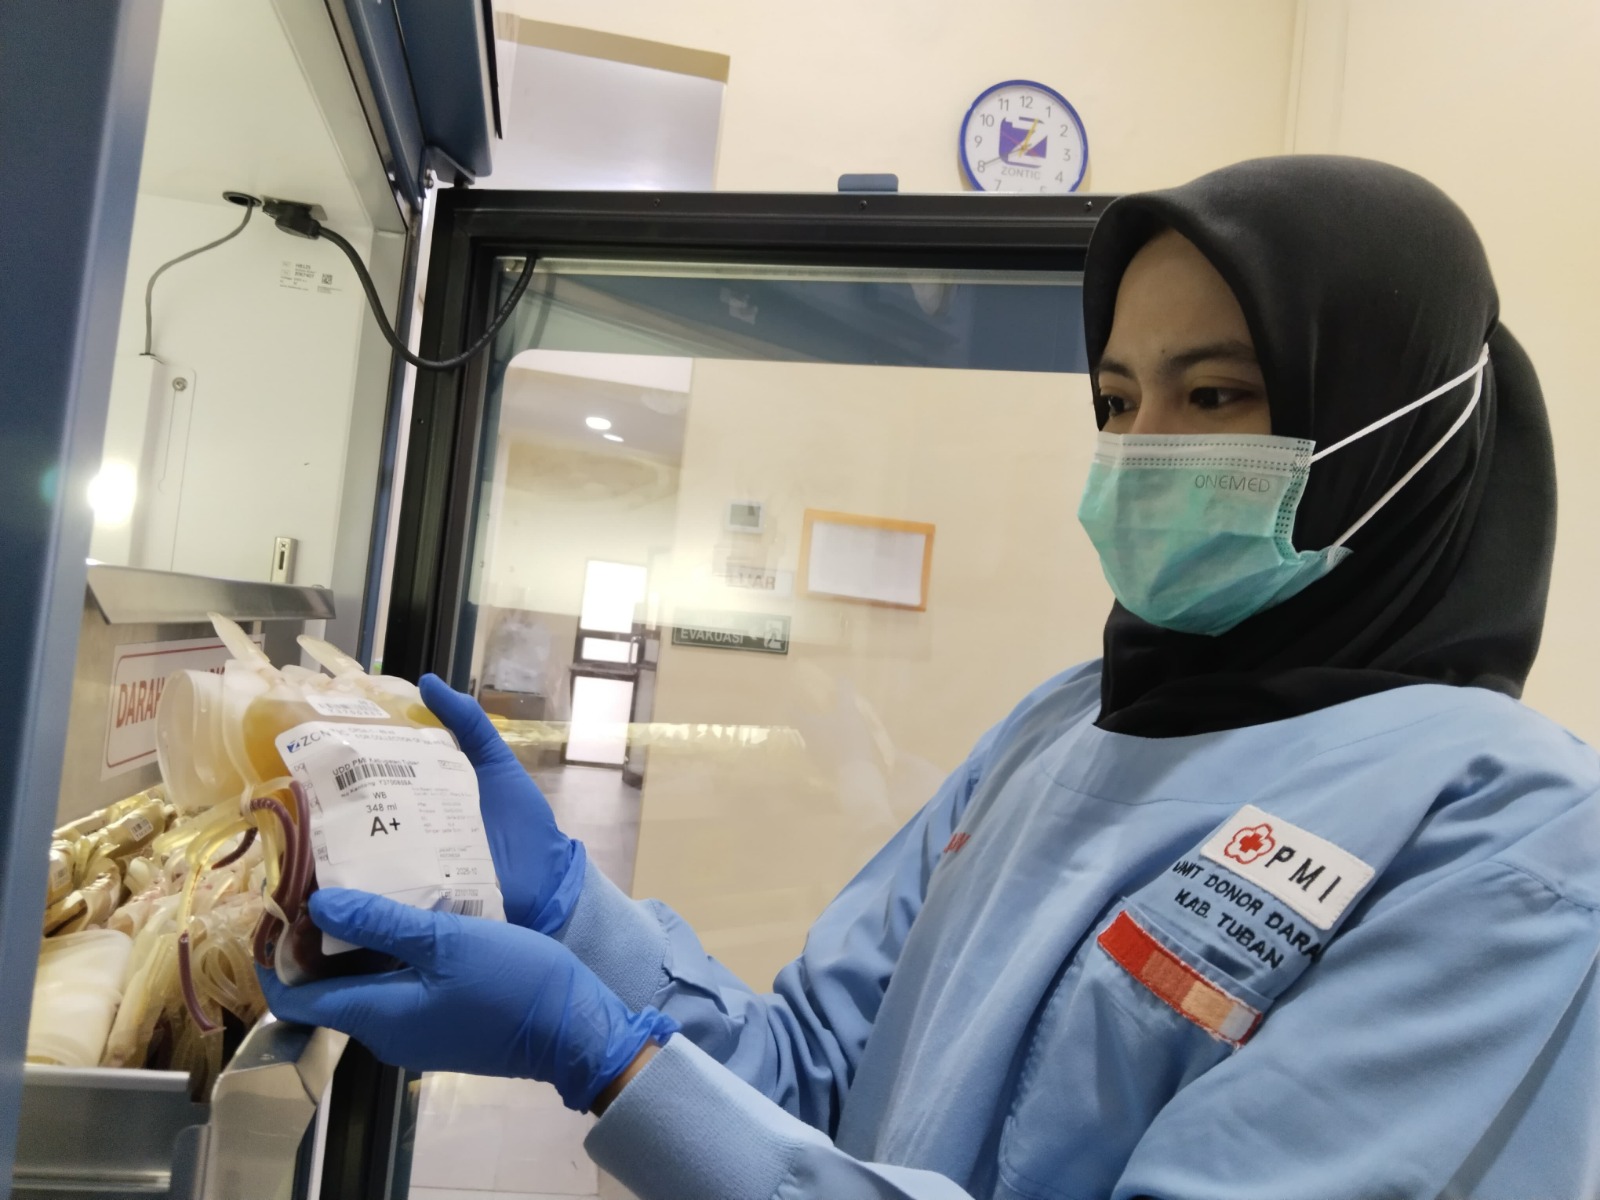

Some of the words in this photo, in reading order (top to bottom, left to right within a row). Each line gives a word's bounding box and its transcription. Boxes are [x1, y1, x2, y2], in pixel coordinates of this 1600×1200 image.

[997, 97, 1010, 112] 11
[1019, 95, 1034, 109] 12
[1045, 105, 1052, 118] 1
[979, 113, 995, 128] 10
[1059, 124, 1069, 138] 2
[973, 135, 983, 148] 9
[1063, 147, 1072, 162] 3
[976, 159, 986, 173] 8
[1054, 170, 1064, 183] 4
[994, 178, 1002, 192] 7
[1194, 474, 1271, 493] ONEMED
[680, 626, 745, 645] EVAKUASI
[372, 791, 388, 800] WB
[366, 803, 385, 813] 348
[370, 816, 401, 837] A+
[1264, 845, 1342, 904] PMI
[1203, 873, 1265, 917] DONOR
[1174, 888, 1212, 919] KAB.
[1216, 911, 1285, 971] TUBAN
